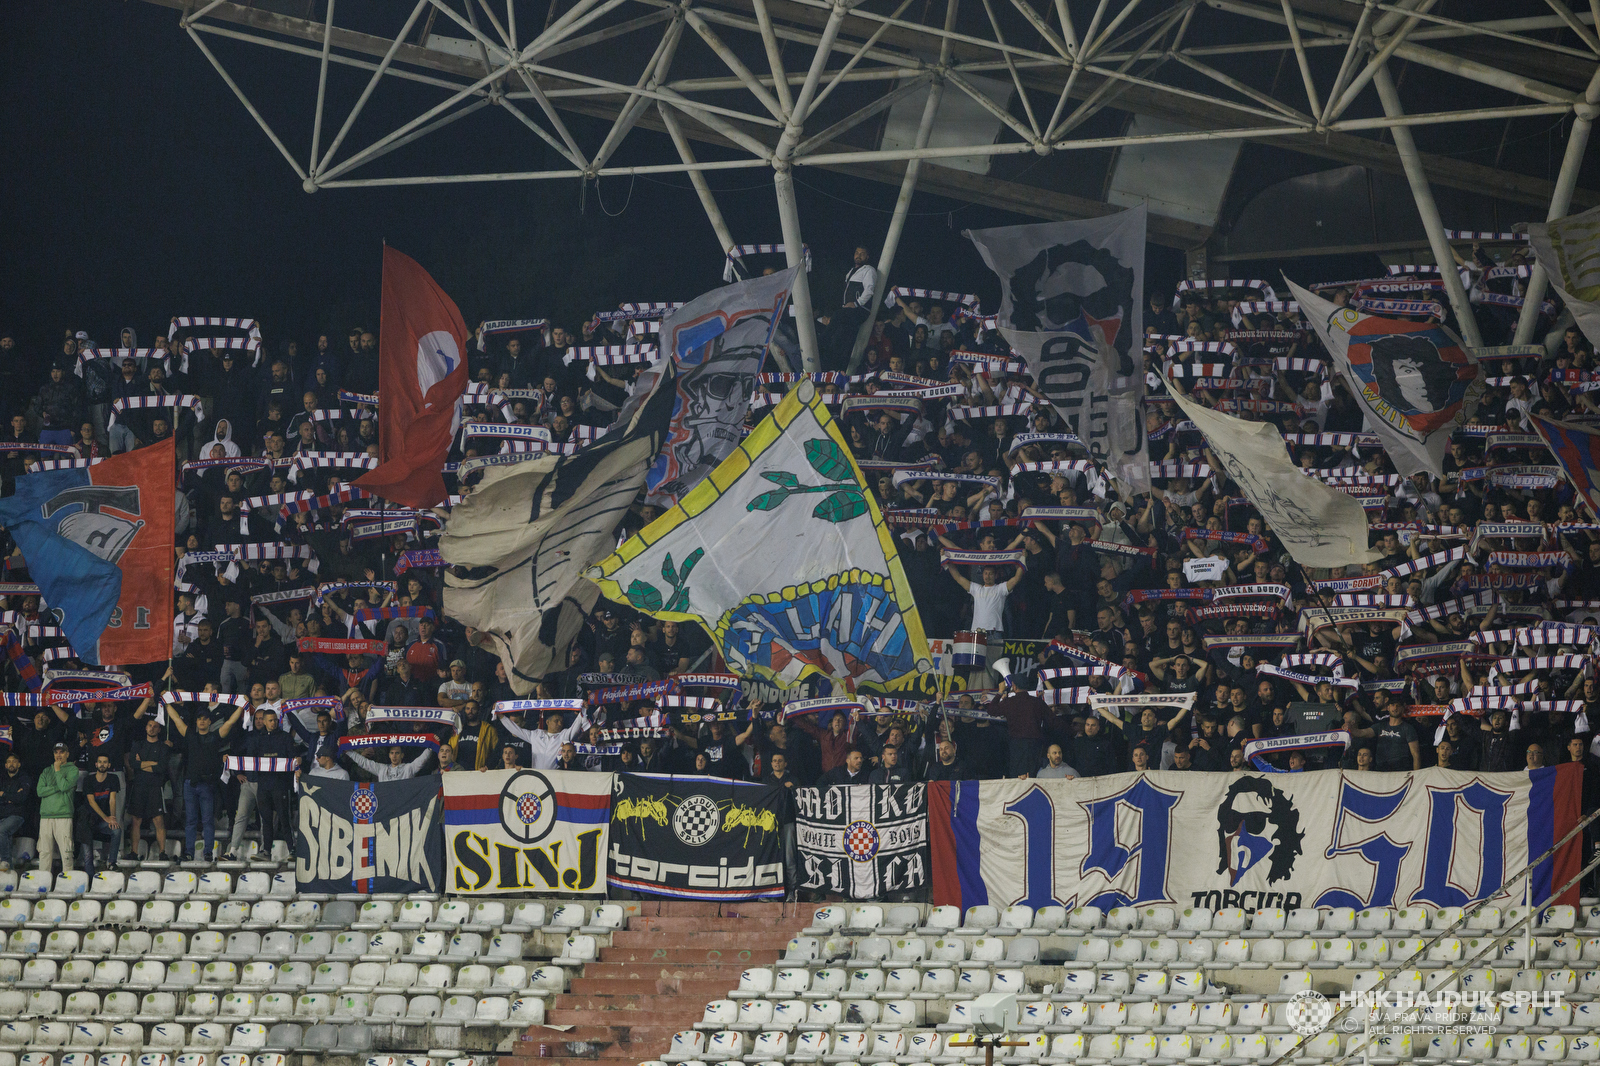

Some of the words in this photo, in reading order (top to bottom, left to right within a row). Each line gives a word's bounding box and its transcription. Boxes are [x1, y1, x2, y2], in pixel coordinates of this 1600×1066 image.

[1371, 283, 1432, 292] TORCIDA
[1364, 301, 1433, 312] HAJDUK
[486, 320, 518, 330] HAJDUK
[521, 318, 543, 326] SPLIT
[1229, 331, 1255, 339] HAJDUK
[1474, 347, 1500, 356] JDUK
[1507, 346, 1532, 355] SPLIT
[888, 373, 907, 381] HAJDUK
[1197, 378, 1261, 388] RUDA
[495, 390, 541, 401] AJDUK
[929, 386, 957, 396] DUHOM
[890, 397, 911, 405] SPLIT
[1223, 401, 1294, 411] RUDA
[470, 425, 532, 436] TORCIDA
[1015, 433, 1055, 441] WHITE
[480, 452, 543, 465] TORCIDA
[1506, 466, 1528, 474] SPLIT
[1529, 466, 1559, 475] ULTRAS
[907, 470, 952, 479] WHITE
[965, 474, 998, 484] BOYS
[1491, 475, 1555, 487] HAJDUK
[1348, 485, 1370, 494] VJEČNO
[1036, 508, 1064, 516] HAJDUK
[1065, 508, 1085, 516] SPLIT
[895, 516, 922, 524] HAJDUK
[363, 522, 392, 534] HAJDUK
[393, 519, 415, 529] SPLIT
[1482, 524, 1543, 534] TORCIDA
[989, 552, 1012, 560] SPLIT
[323, 580, 394, 592] TORCIDA
[1468, 574, 1539, 589] HAJDUK
[253, 588, 312, 604] ONAVLE
[1257, 585, 1287, 596] DUHOM
[1204, 605, 1229, 614] HAJDUK
[1243, 603, 1267, 613] VJEČNO
[1509, 605, 1532, 613] SPLIT
[1319, 611, 1386, 622] TORCIDA
[318, 642, 332, 650] SPORT
[332, 642, 347, 650] LISBOA
[350, 642, 368, 650] BENFICA
[1056, 642, 1098, 661] WHITE
[1411, 645, 1443, 655] HAJDUK
[1445, 643, 1468, 652] SPLIT
[56, 670, 89, 678] HAJDUK
[679, 675, 738, 686] TORCIDA
[51, 692, 89, 701] TORCIDA
[113, 687, 149, 698] CAVTAT
[602, 688, 628, 699] Hajduk
[629, 686, 643, 697] živi
[644, 683, 668, 695] vječno!
[740, 680, 809, 704] PANDURE
[285, 697, 333, 709] HAJDUK
[512, 699, 575, 709] HAJDUK
[800, 699, 833, 708] HAJDUK
[1096, 696, 1138, 704] WHITE
[1150, 695, 1187, 704] BOYS
[384, 708, 443, 719] TORCIDA
[681, 714, 701, 723] 19
[717, 712, 737, 721] 11
[601, 727, 662, 741] HAJDUK
[348, 736, 388, 747] WHITE
[398, 735, 426, 744] BOYS
[1267, 737, 1300, 748] HAJDUK
[1304, 734, 1327, 744] SPLIT
[353, 790, 374, 800] HAJDUK
[679, 797, 717, 815] HAJDUK
[846, 821, 876, 835] HAJDUK
[296, 781, 438, 892] ŠIBENIK
[679, 833, 709, 843] SPLIT
[454, 828, 603, 892] SINJ
[849, 850, 874, 861] SPLIT
[1191, 888, 1303, 915] TORCIDA
